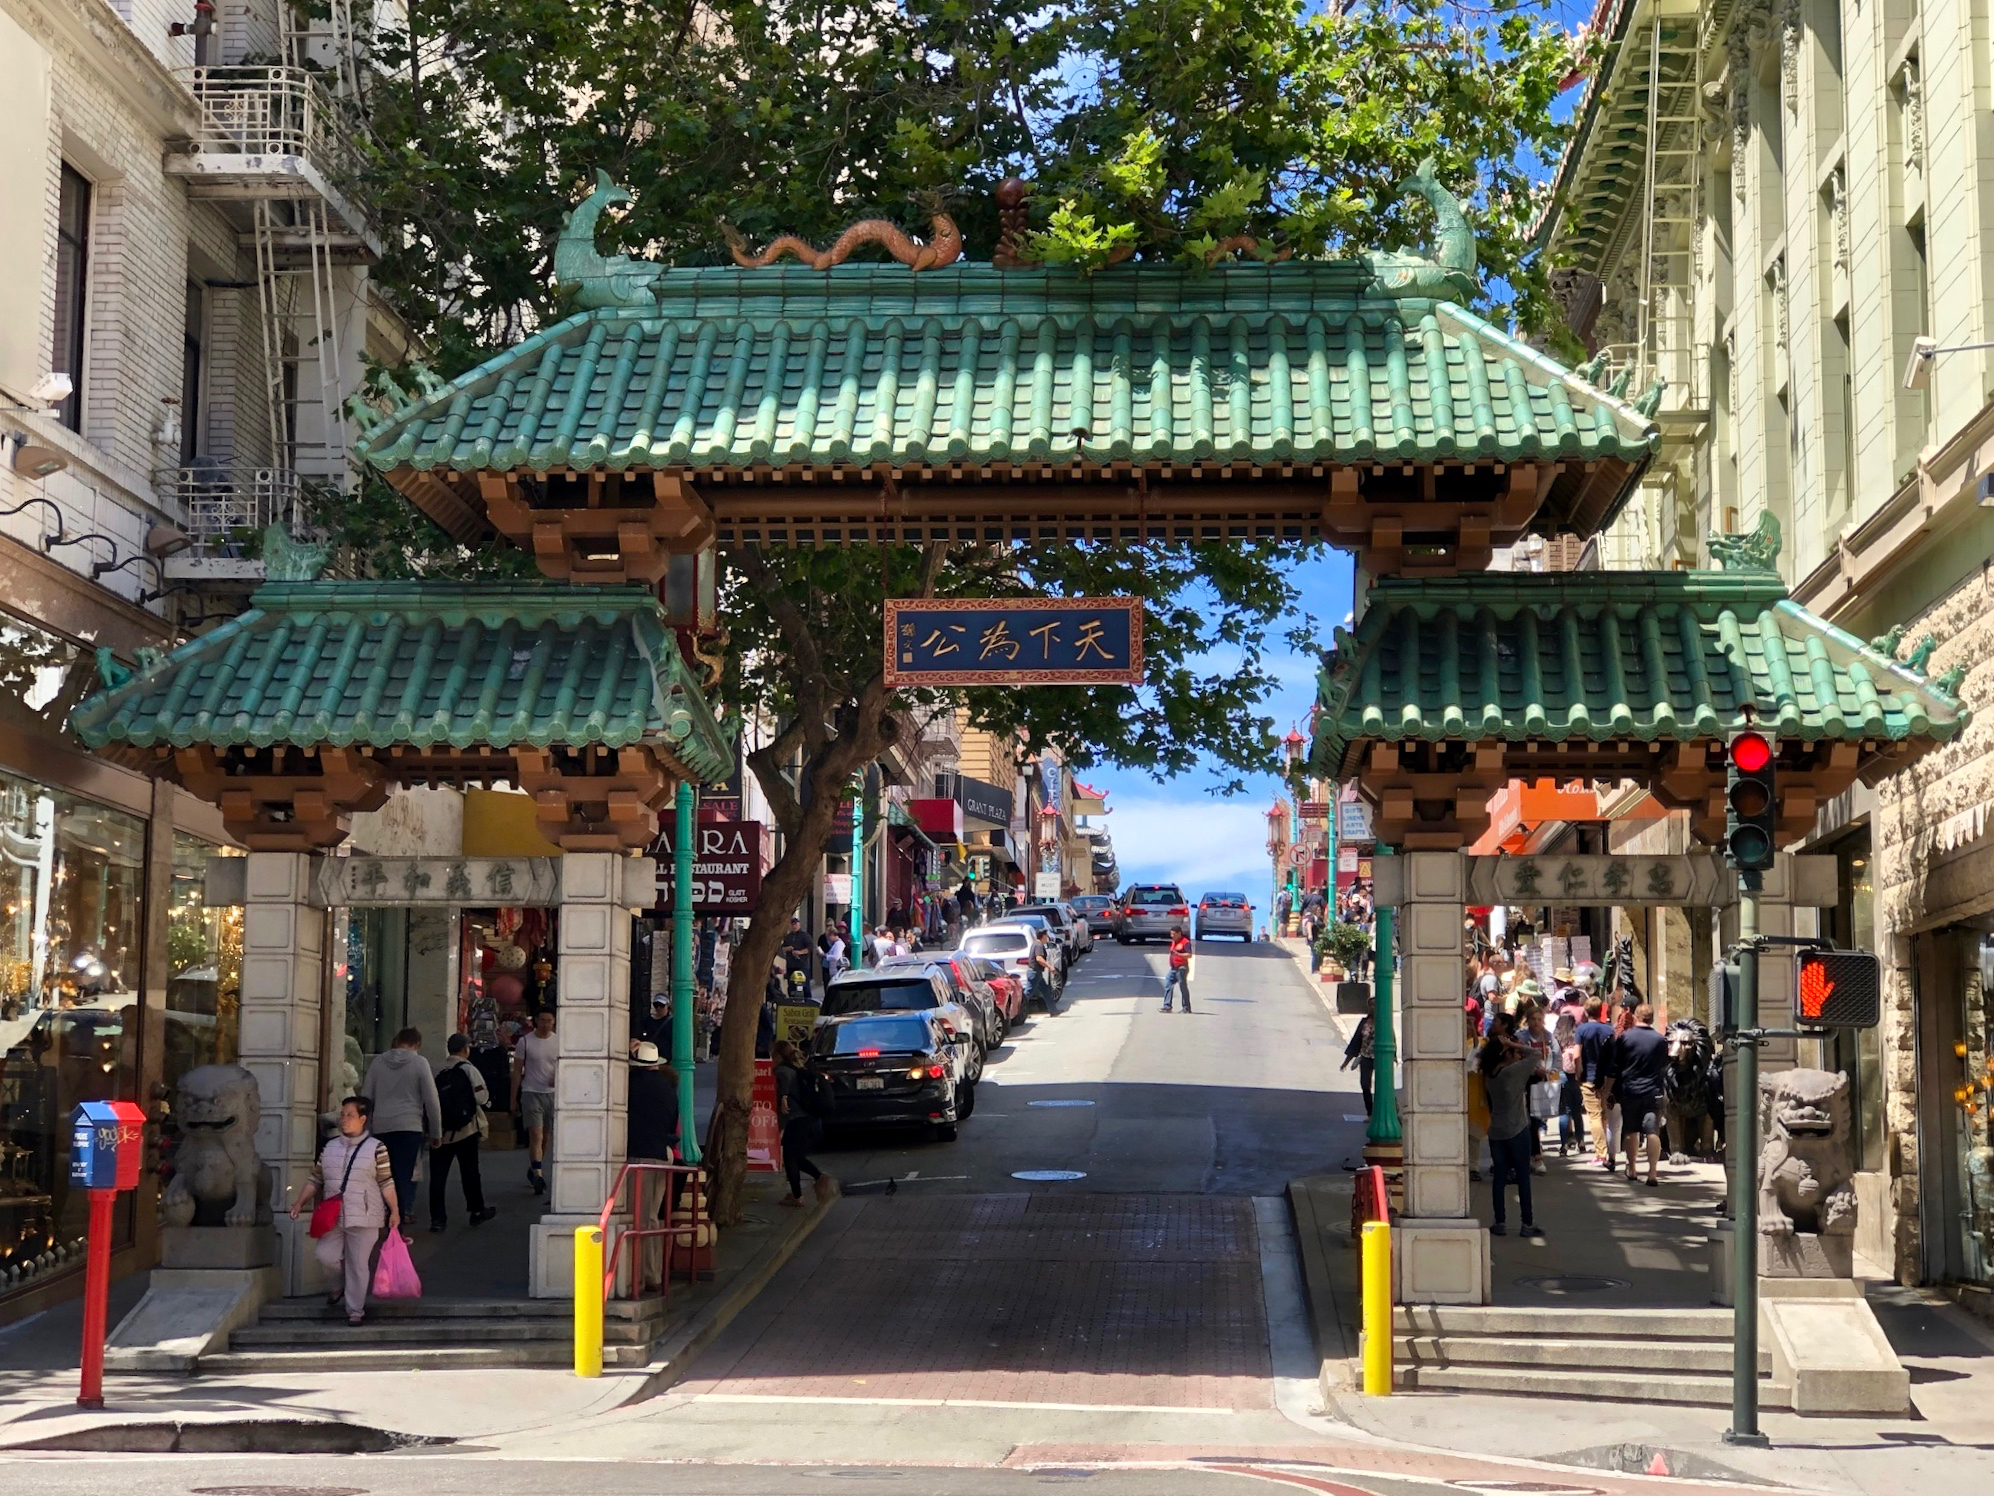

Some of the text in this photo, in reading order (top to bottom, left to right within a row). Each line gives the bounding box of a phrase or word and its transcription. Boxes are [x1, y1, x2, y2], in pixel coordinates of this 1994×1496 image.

[919, 619, 1115, 662] 天下為公
[703, 801, 738, 811] SALE
[967, 798, 1007, 821] GRANT PLAZA
[783, 1008, 815, 1018] Sabra Grill
